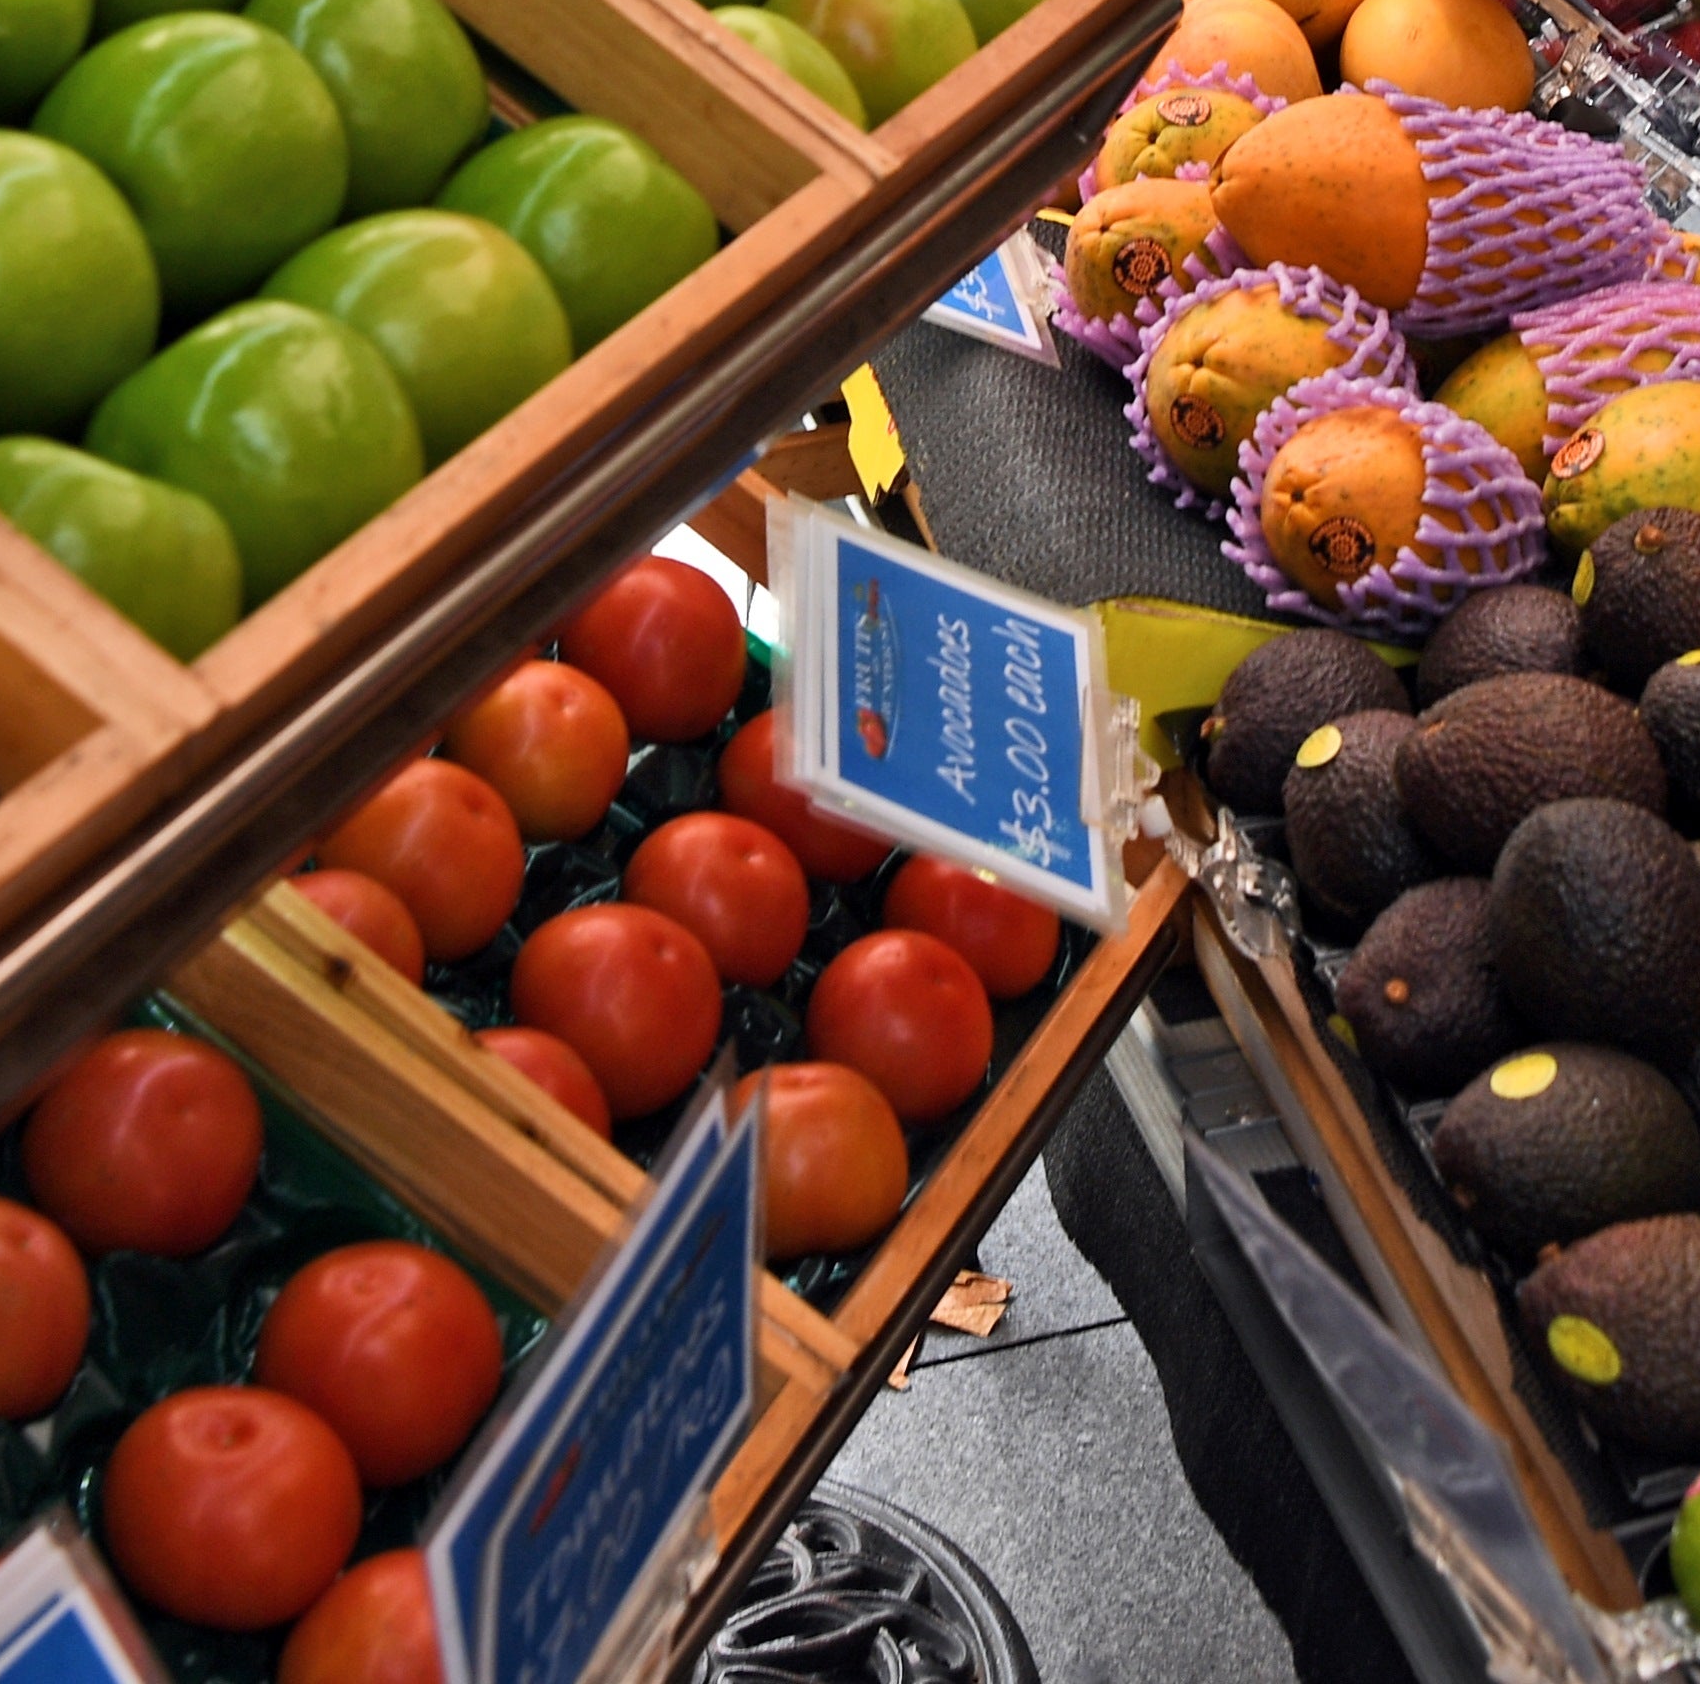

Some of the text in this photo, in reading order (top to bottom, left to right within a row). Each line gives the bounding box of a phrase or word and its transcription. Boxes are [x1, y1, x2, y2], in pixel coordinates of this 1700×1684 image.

[927, 613, 976, 806] Avocadoes
[991, 618, 1071, 868] $3.00 each
